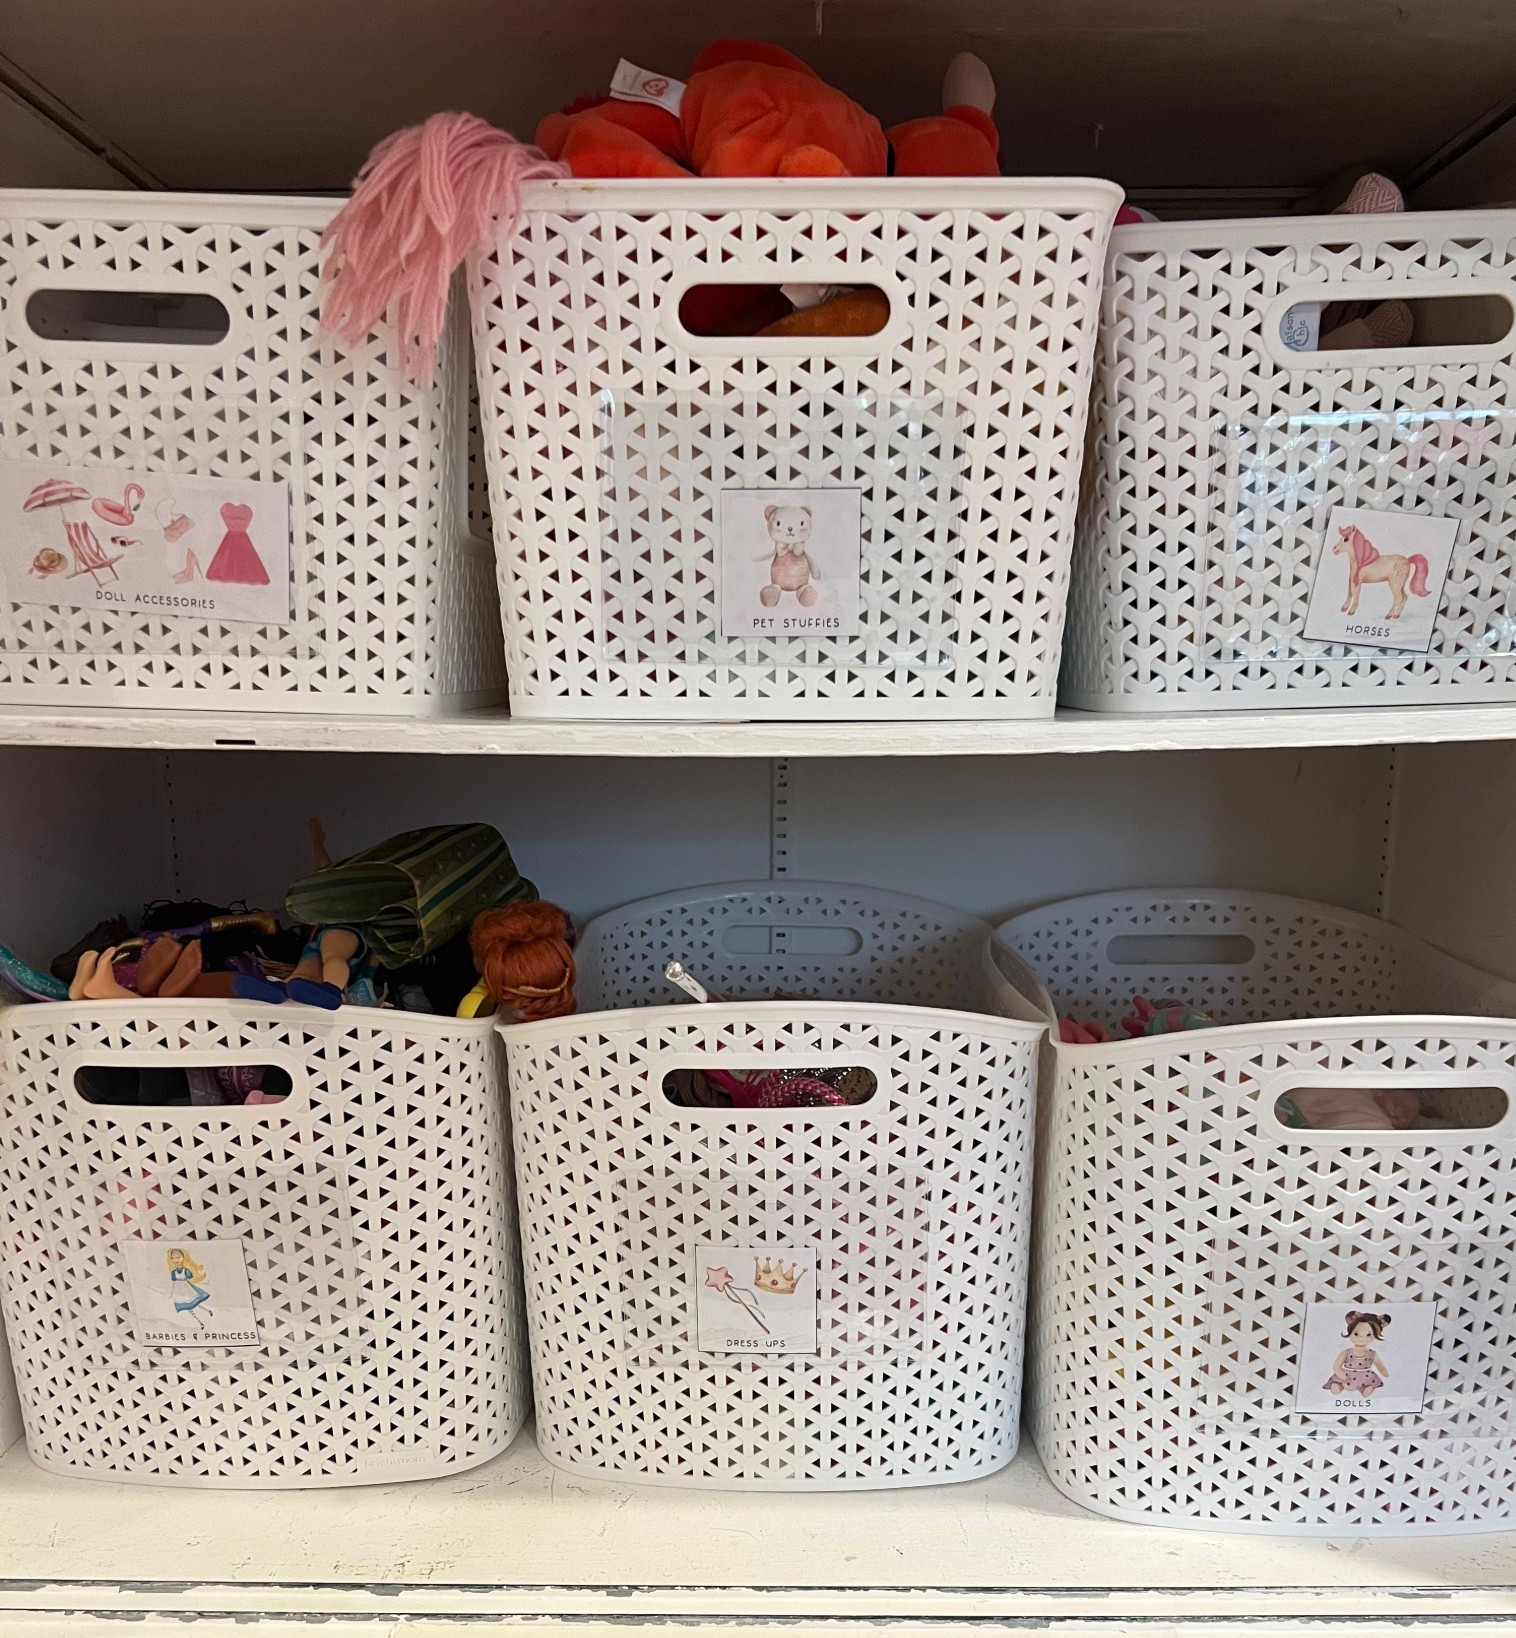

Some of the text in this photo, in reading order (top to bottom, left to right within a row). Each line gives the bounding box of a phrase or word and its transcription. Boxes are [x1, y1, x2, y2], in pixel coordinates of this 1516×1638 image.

[95, 590, 216, 610] DOLL ACCESSORIES
[753, 617, 840, 629] PET STUFFIES
[1345, 624, 1391, 638] HORSES
[145, 1332, 186, 1341] BARBIES
[204, 1331, 256, 1340] PRINCESS
[726, 1339, 786, 1348] DRESS UPS
[1335, 1399, 1371, 1407] DOLLS
[364, 1455, 426, 1468] brightroom
